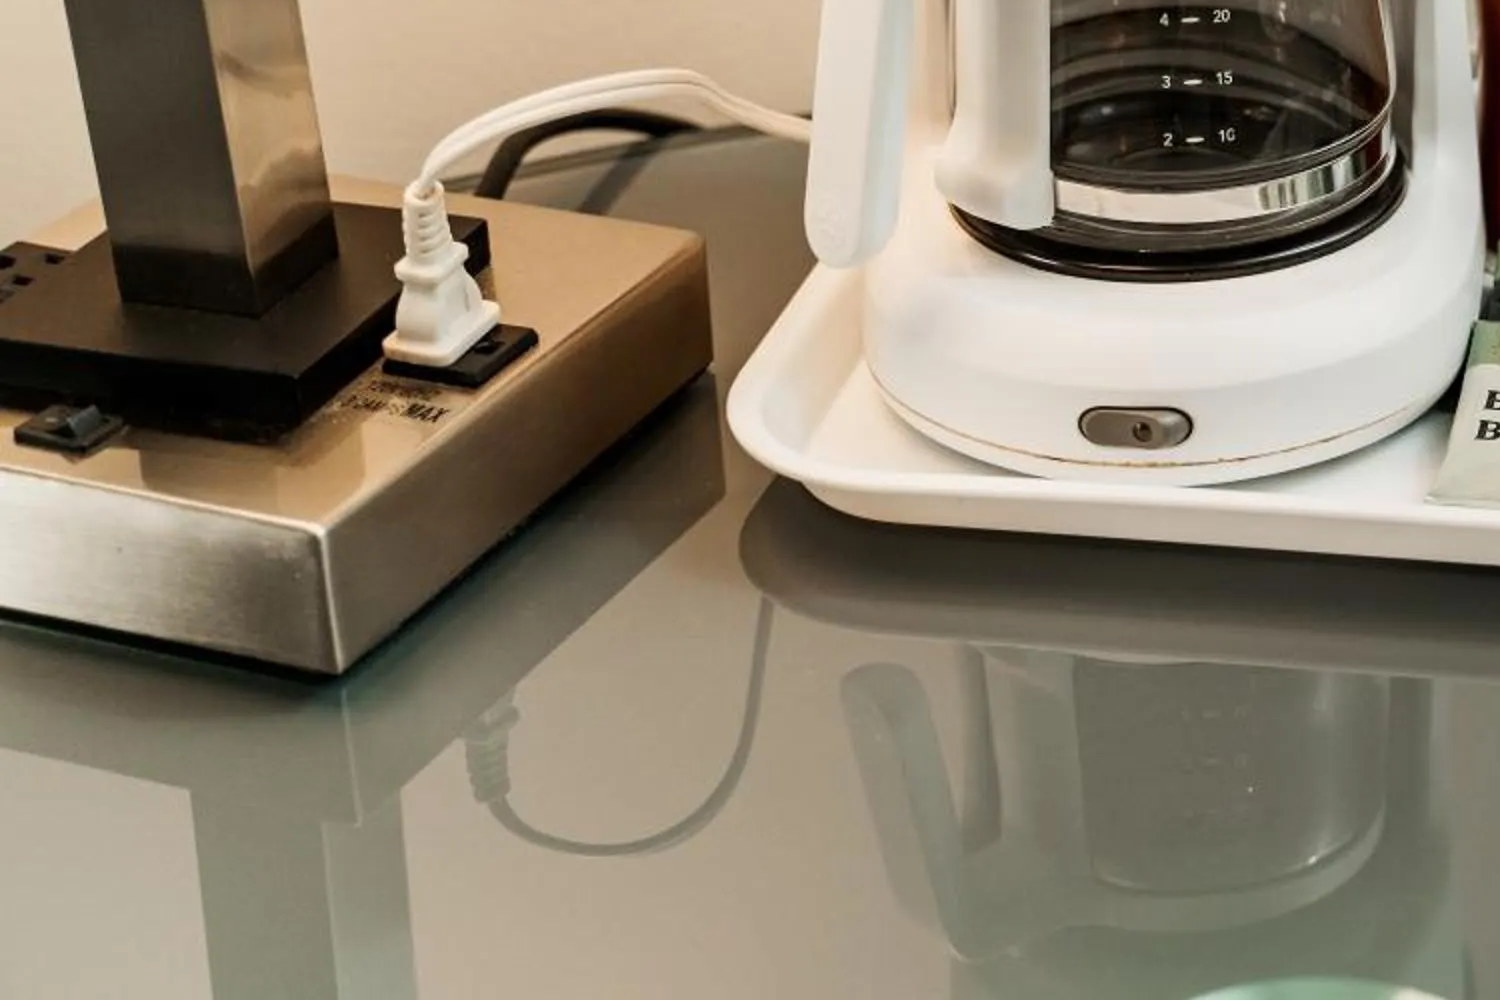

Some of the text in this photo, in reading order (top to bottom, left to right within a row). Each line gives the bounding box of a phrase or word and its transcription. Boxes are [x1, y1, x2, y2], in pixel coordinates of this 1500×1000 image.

[1159, 9, 1231, 27] 4 20
[1162, 70, 1233, 89] 3 15
[1162, 127, 1236, 147] 2 10
